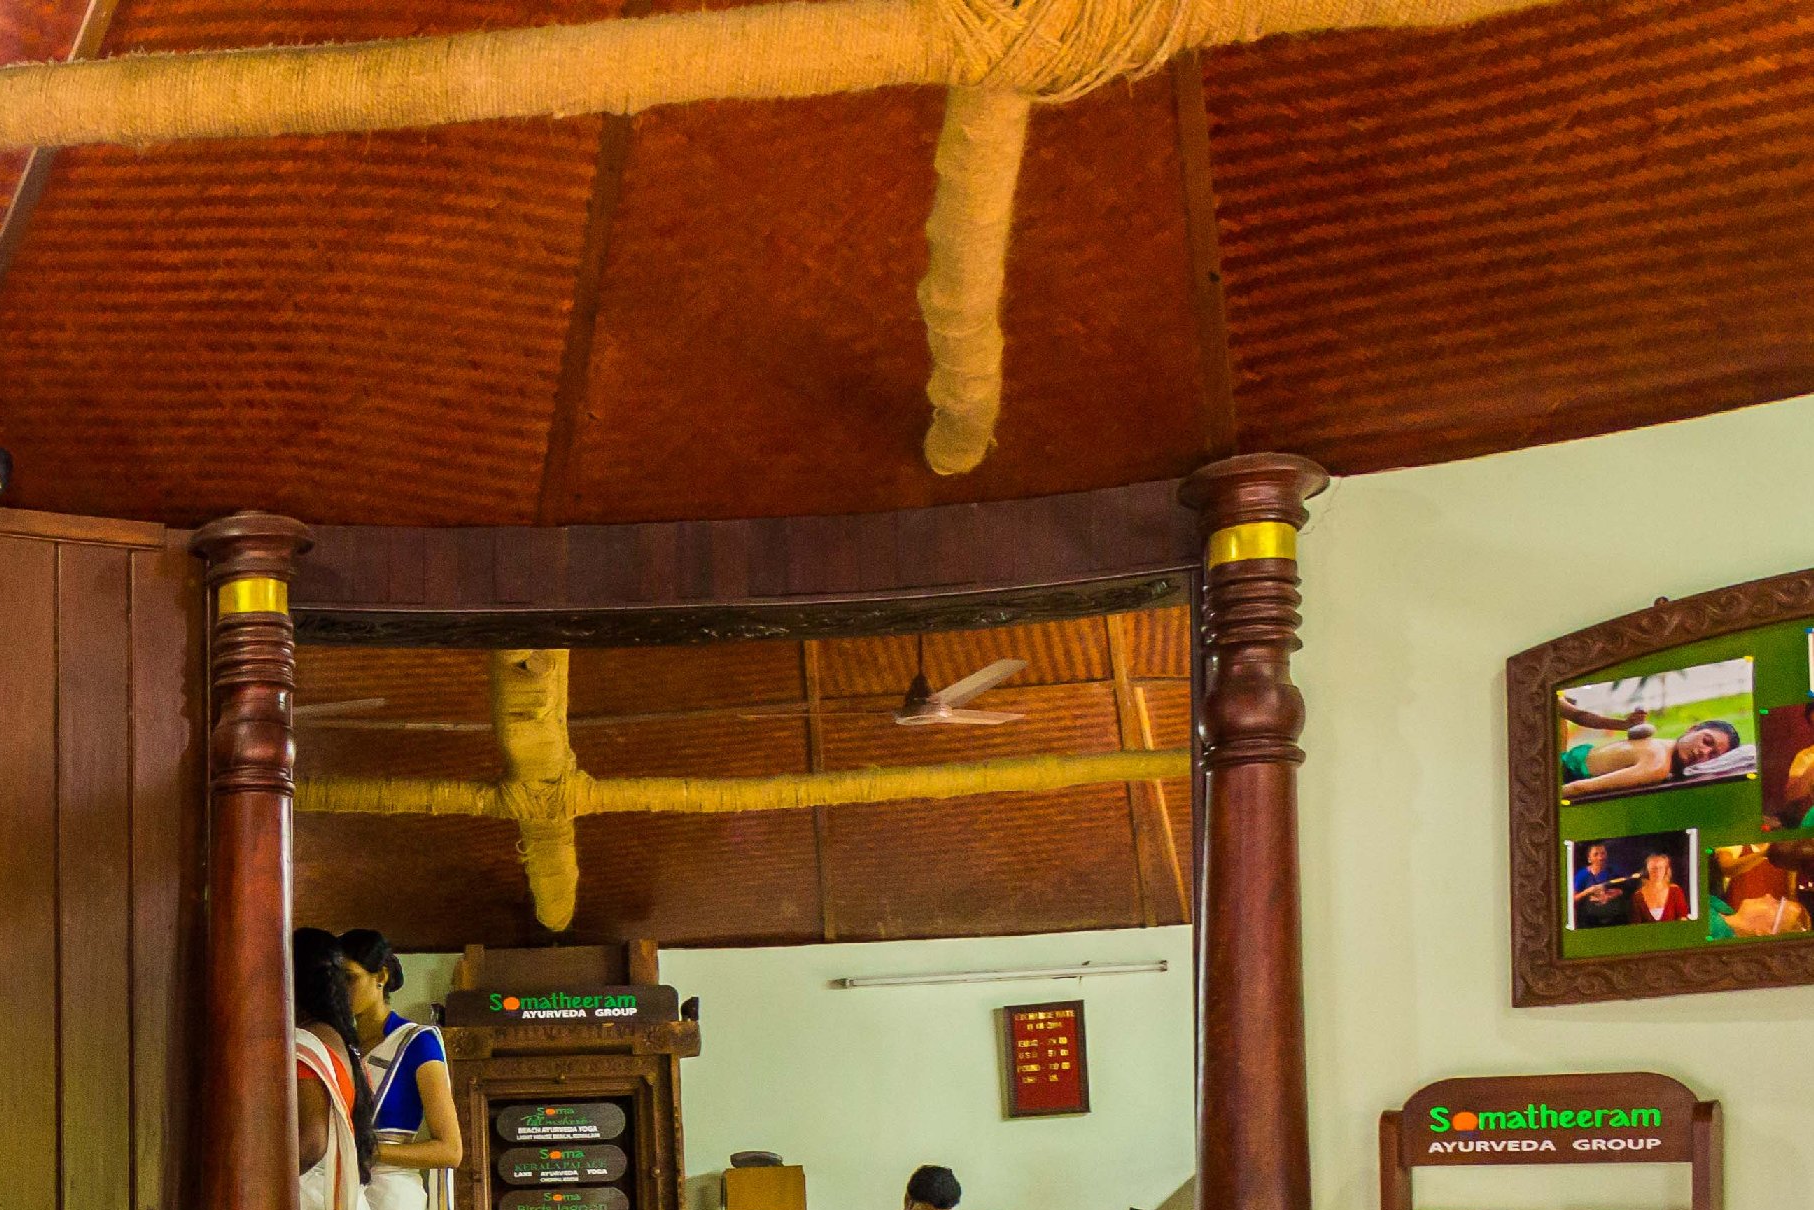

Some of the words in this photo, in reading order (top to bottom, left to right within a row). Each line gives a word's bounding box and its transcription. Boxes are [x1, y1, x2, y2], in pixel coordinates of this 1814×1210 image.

[489, 992, 636, 1012] Somatheeram
[522, 1009, 587, 1019] AYURVEDA
[595, 1007, 637, 1017] GROUP
[536, 1106, 575, 1116] Soma
[1429, 1103, 1662, 1133] Somatheeram
[578, 1125, 598, 1133] YOGA
[1428, 1139, 1557, 1154] AYURVEDA
[1572, 1138, 1662, 1151] GROUP
[539, 1149, 585, 1159] Soma
[543, 1192, 581, 1201] Soma
